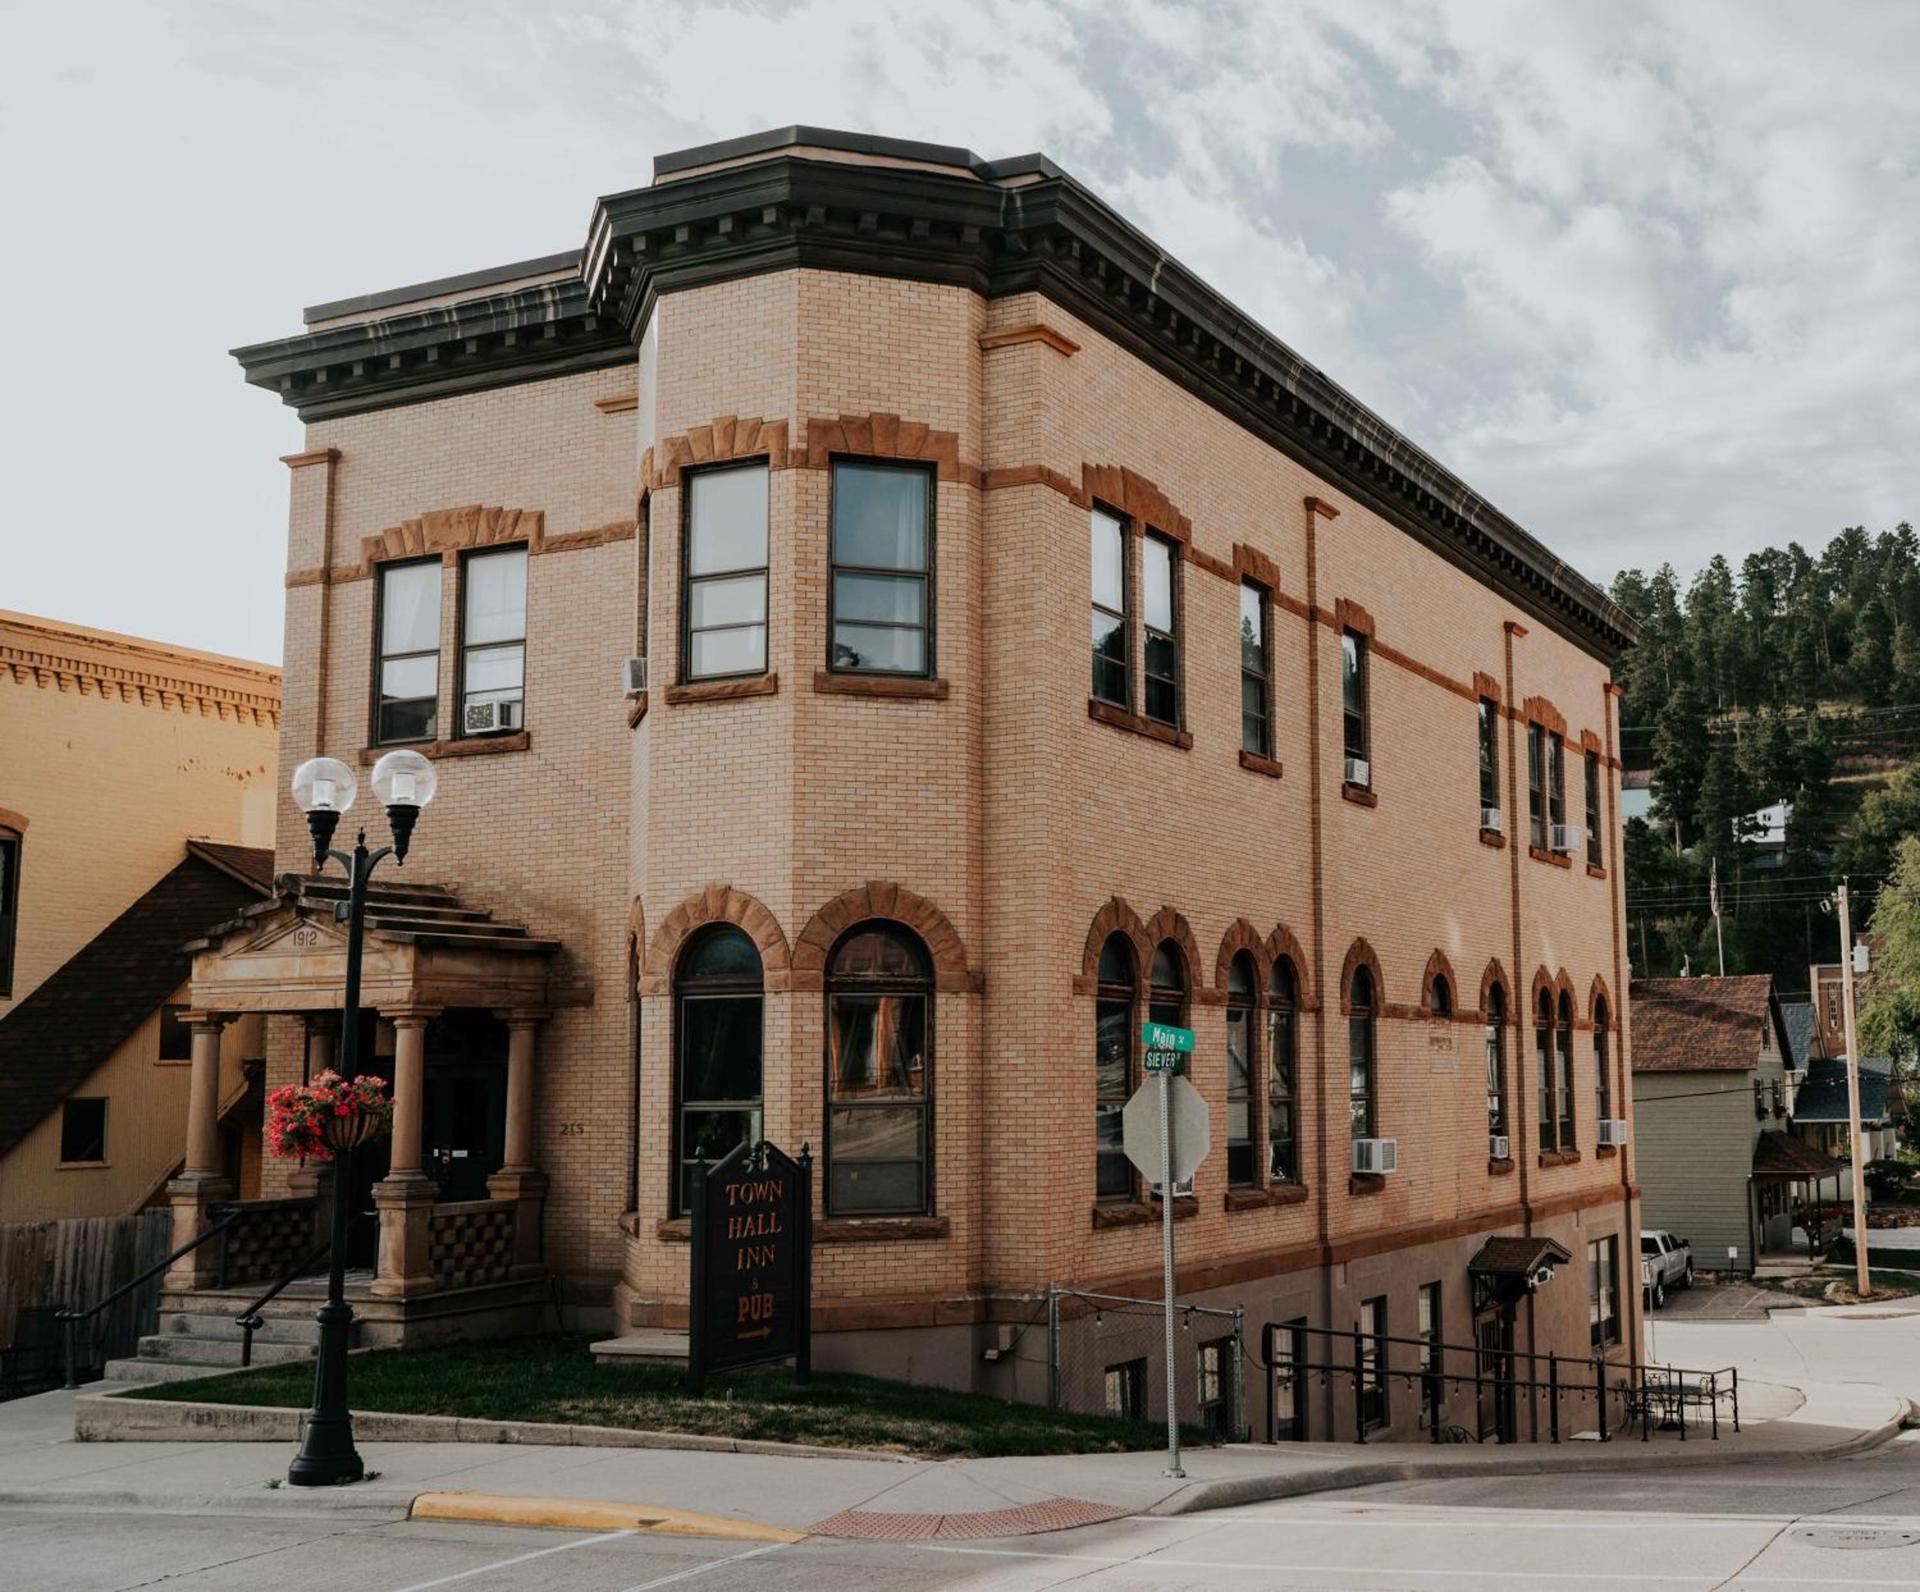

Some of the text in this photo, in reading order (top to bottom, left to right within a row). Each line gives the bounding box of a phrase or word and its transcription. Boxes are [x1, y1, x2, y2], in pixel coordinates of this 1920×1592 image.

[293, 931, 318, 946] 1912
[1152, 1026, 1176, 1047] Main
[1146, 1051, 1176, 1068] SIEVER
[560, 1123, 584, 1136] 215
[725, 1180, 783, 1206] TOWN
[728, 1212, 783, 1239] HALL
[737, 1244, 775, 1271] INN
[737, 1293, 774, 1323] PUB
